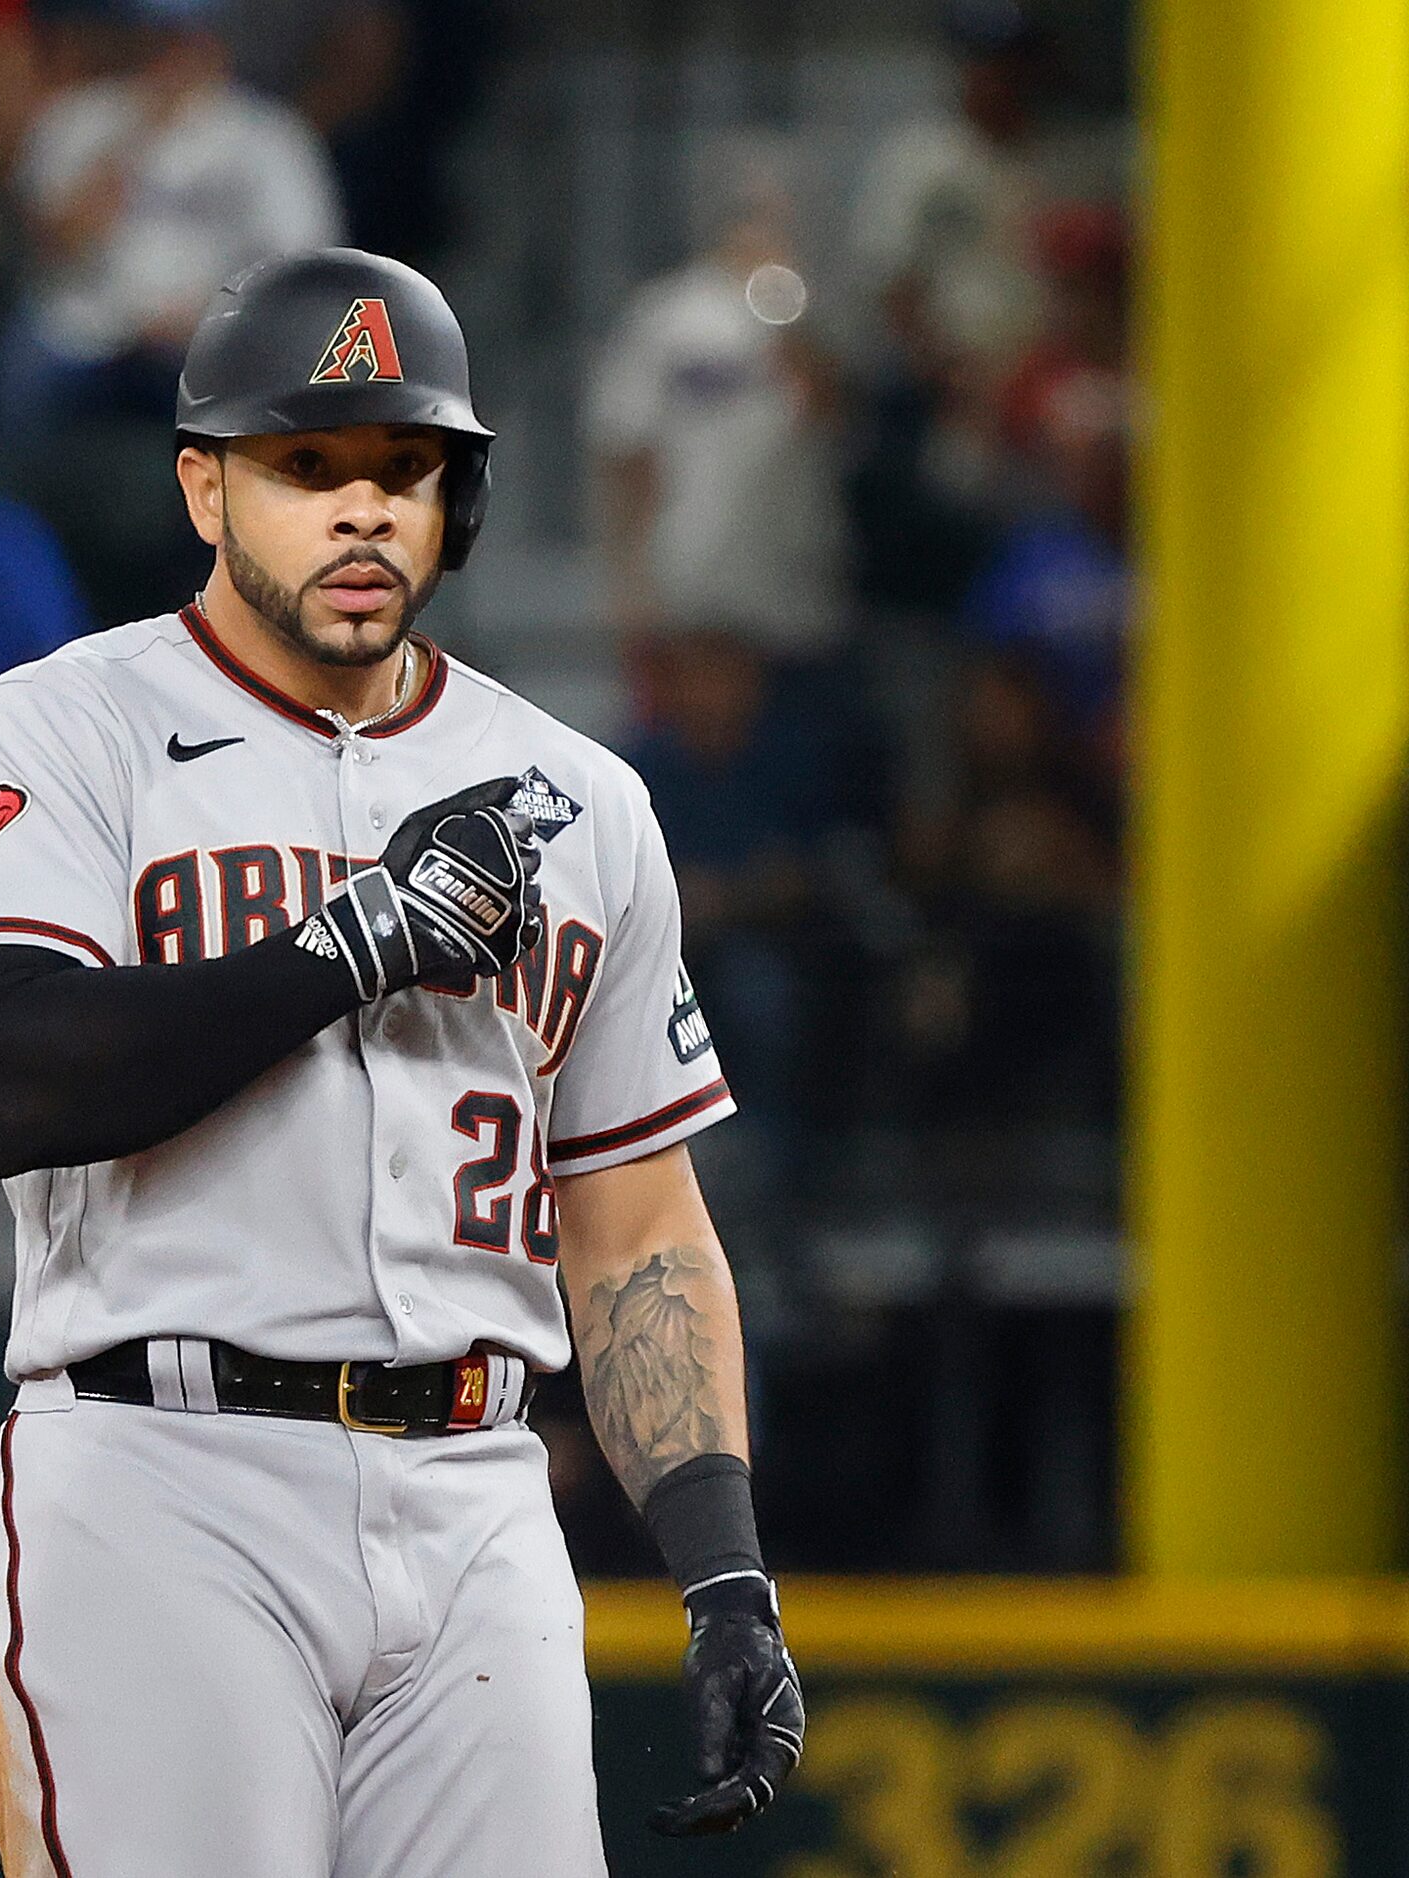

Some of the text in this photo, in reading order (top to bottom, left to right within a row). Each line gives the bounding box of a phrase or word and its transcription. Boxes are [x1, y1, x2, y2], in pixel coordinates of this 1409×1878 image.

[308, 298, 404, 385] A
[415, 860, 501, 925] Franklin
[135, 844, 605, 1079] ARINA
[451, 1090, 561, 1266] 28
[460, 1366, 484, 1406] 28
